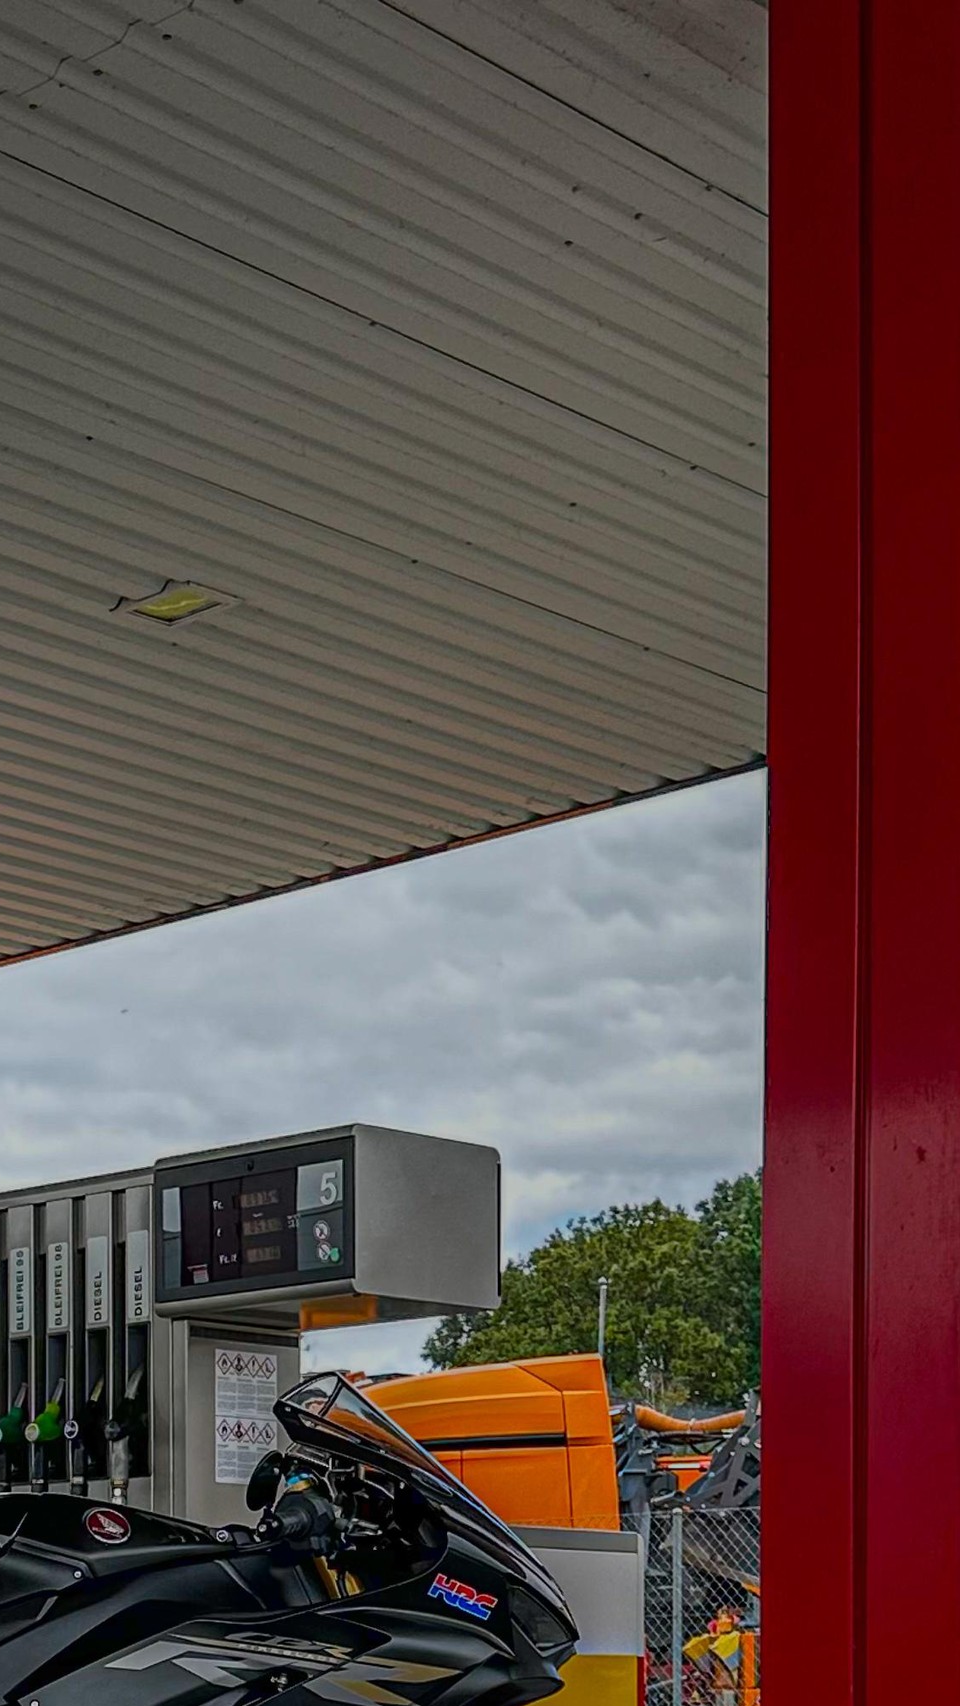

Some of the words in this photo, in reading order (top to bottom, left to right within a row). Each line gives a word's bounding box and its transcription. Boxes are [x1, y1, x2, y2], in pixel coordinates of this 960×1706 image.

[319, 1171, 338, 1206] 5
[16, 1270, 24, 1330] BLEIFREI
[54, 1265, 62, 1326] BLEIFREI
[94, 1271, 102, 1321] DIESEL
[134, 1265, 143, 1317] DIESEL
[427, 1573, 499, 1621] HRC
